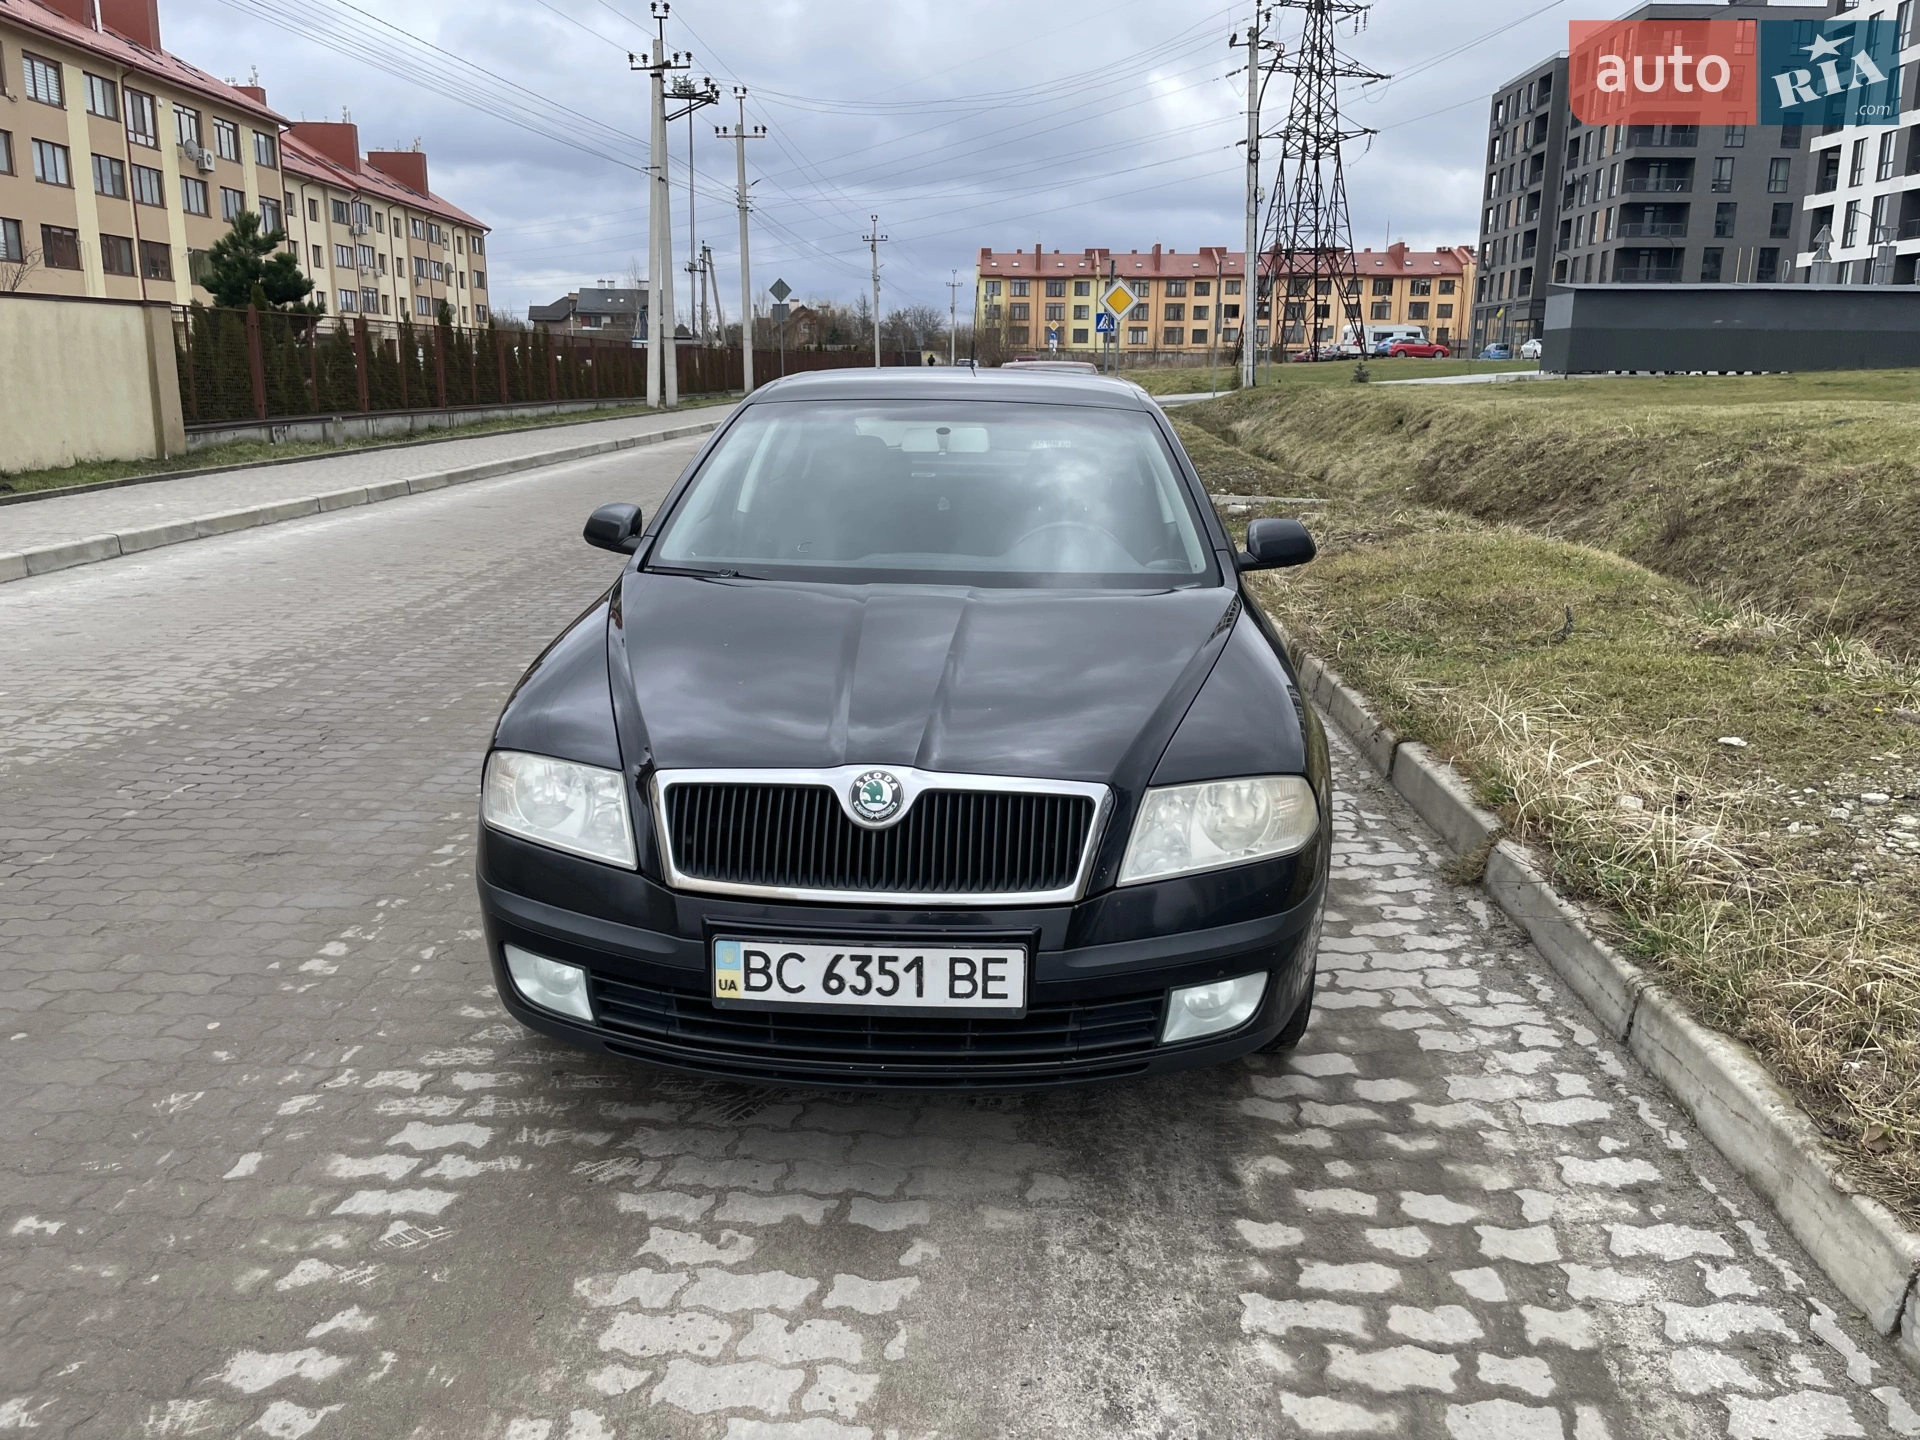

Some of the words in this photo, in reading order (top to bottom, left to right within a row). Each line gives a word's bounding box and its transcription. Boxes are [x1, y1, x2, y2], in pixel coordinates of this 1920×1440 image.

[718, 979, 738, 991] UA
[743, 949, 806, 994] BC
[822, 954, 924, 998] 6351
[949, 957, 1008, 1000] BE
